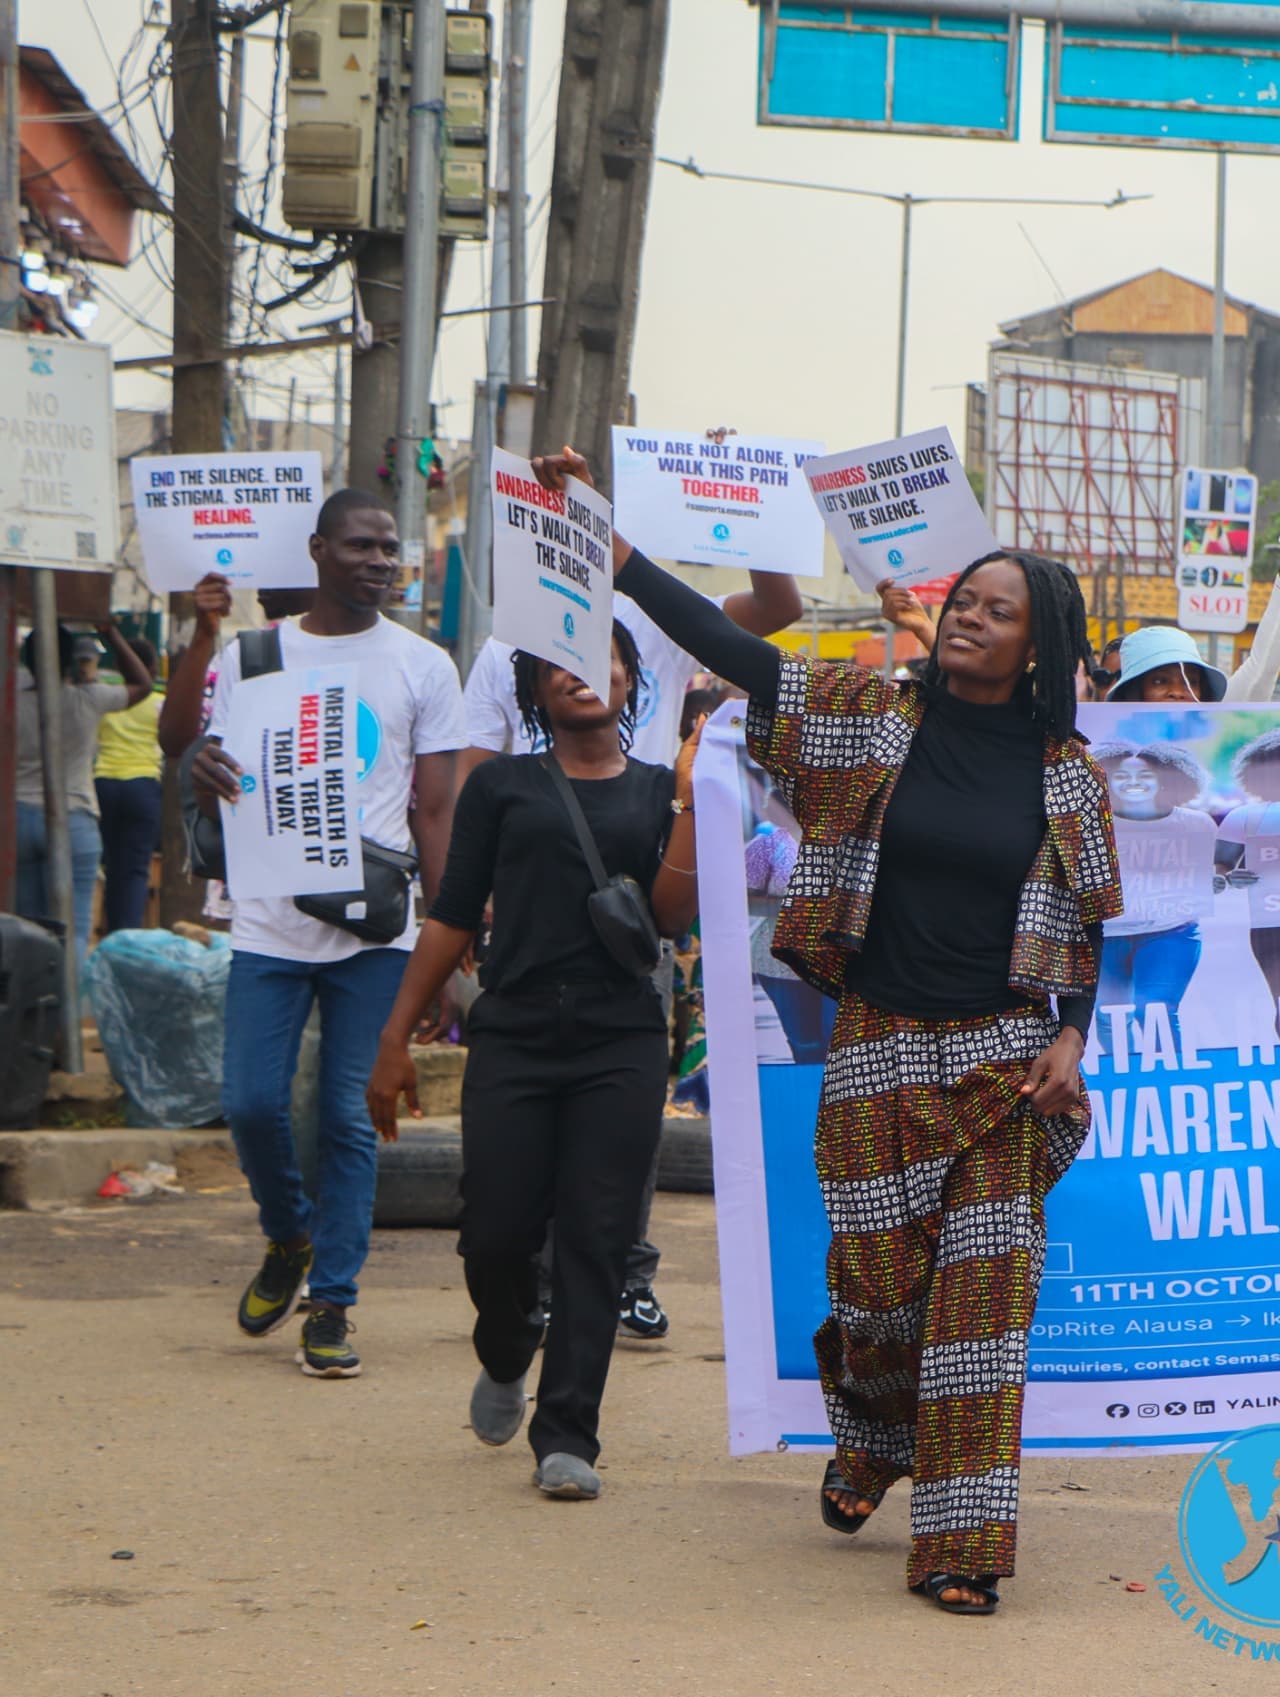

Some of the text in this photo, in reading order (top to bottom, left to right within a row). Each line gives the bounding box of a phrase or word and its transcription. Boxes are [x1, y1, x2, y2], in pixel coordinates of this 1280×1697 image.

[26, 391, 59, 417] NO
[21, 448, 66, 477] ANY
[626, 438, 658, 453] YOU
[664, 441, 694, 456] ARE
[700, 444, 730, 459] NOT
[151, 467, 303, 488] END THE SILENCE. END
[658, 457, 788, 487] WALK THIS PATH
[810, 444, 953, 494] AWARENESS SAVES LIVES.
[20, 478, 72, 506] TIME
[145, 487, 312, 508] THE STIGMA. START THE
[495, 470, 566, 516] AWARENESS
[567, 496, 591, 532] SAVES
[681, 478, 764, 504] TOGETHER.
[823, 467, 950, 513] LET'S WALK TO BREAK
[193, 508, 256, 526] HEALING.
[848, 499, 924, 531] THE SILENCE.
[508, 502, 606, 576] LET'S WALK TO BREAK
[535, 541, 592, 593] THE SILENCE.
[1189, 595, 1244, 615] SLOT
[273, 726, 297, 835] THAT WAY.
[324, 686, 349, 868] MENTAL HEALTH IS
[299, 778, 322, 839] TREAT
[304, 846, 325, 865] IT
[1118, 838, 1199, 868] ENTAL
[1070, 1281, 1155, 1303] 11TH
[1031, 1318, 1115, 1340] opRite
[1125, 1317, 1213, 1334] Alausa
[1031, 1359, 1129, 1374] enquiries,
[1134, 1355, 1210, 1371] contact
